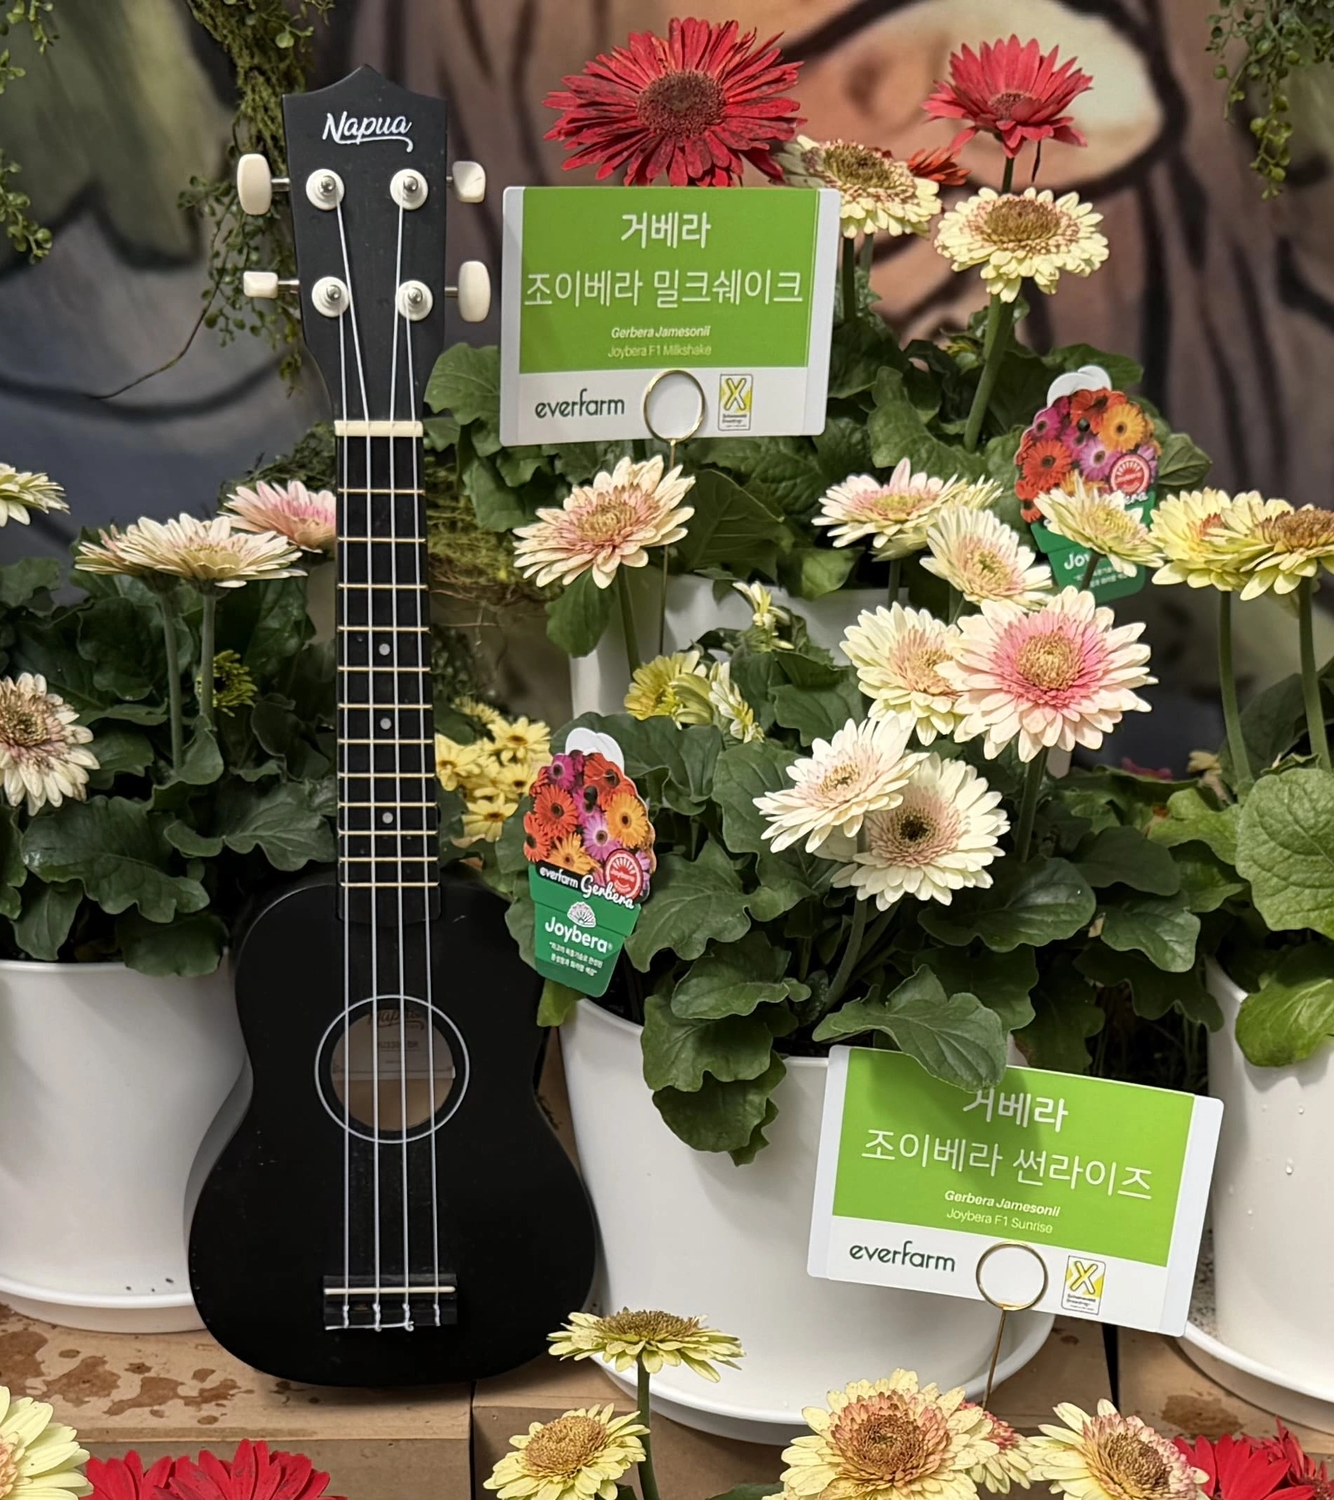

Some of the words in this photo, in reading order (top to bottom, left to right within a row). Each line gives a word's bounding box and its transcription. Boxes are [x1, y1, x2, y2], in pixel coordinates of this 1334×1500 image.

[322, 111, 412, 152] Napua
[621, 212, 711, 249] 거베라
[524, 270, 643, 307] 조이베라
[653, 269, 803, 308] 밀크쉐이크
[611, 326, 654, 338] Gerbera
[655, 326, 711, 338] Jamesonii
[608, 345, 647, 358] Joybera
[649, 345, 661, 356] F1
[663, 344, 712, 356] Milkshake
[535, 388, 624, 419] everfarm
[540, 866, 578, 889] everfarm
[580, 875, 635, 910] Gerbera
[963, 1089, 1069, 1132] 거베라
[861, 1129, 1003, 1177] 조이베라
[1013, 1149, 1152, 1200] 썬라이즈
[944, 1190, 996, 1209] Gerbera
[996, 1197, 1061, 1218] Jamesonii
[946, 1207, 993, 1226] Joybera
[994, 1214, 1009, 1227] F1
[1010, 1217, 1053, 1234] Sunrise
[849, 1241, 955, 1273] everfarm
